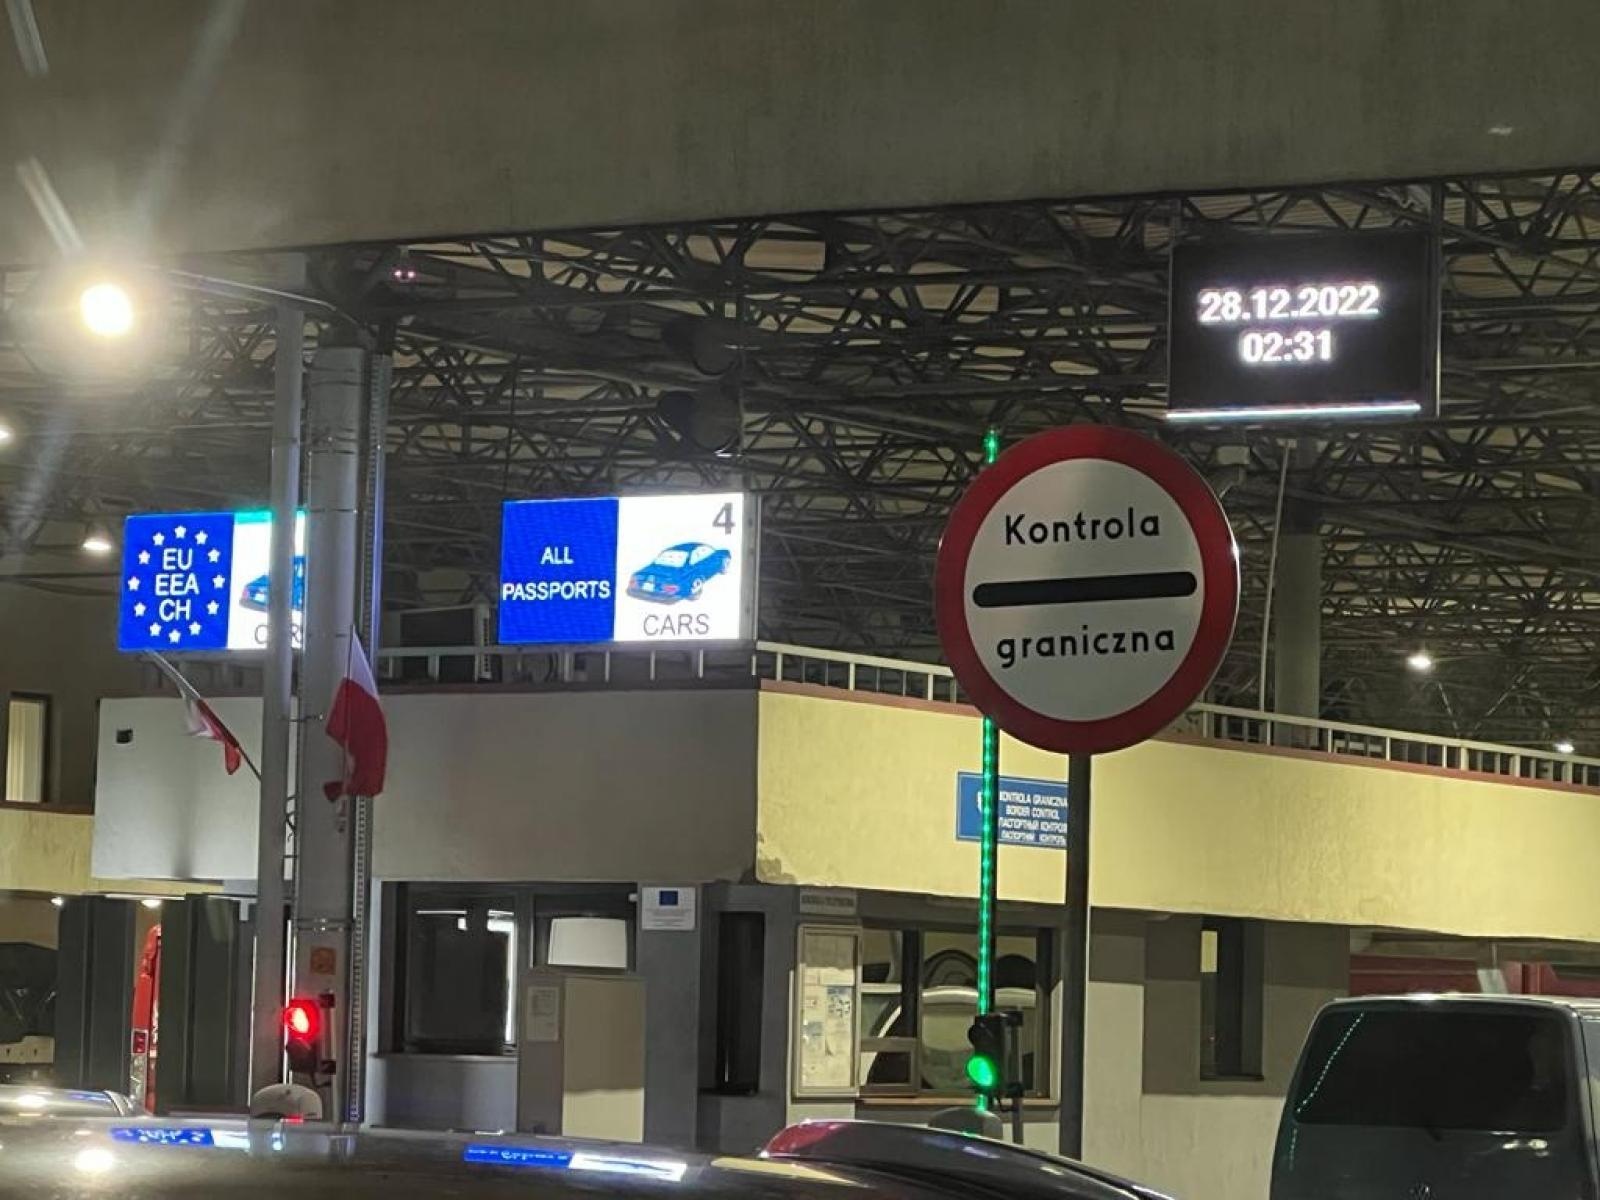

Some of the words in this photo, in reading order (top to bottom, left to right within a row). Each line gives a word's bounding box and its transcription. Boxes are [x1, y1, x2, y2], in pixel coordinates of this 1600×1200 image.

[1198, 284, 1380, 322] 28.12.2022
[1241, 329, 1332, 363] 02:31
[712, 502, 735, 535] 4
[1005, 507, 1160, 545] Kontrola
[162, 548, 193, 570] EU
[540, 547, 574, 565] ALL
[155, 573, 199, 596] EEA
[502, 580, 611, 601] PASSPORTS
[158, 599, 192, 622] CH
[642, 613, 710, 636] CARS
[997, 624, 1175, 669] graniczna
